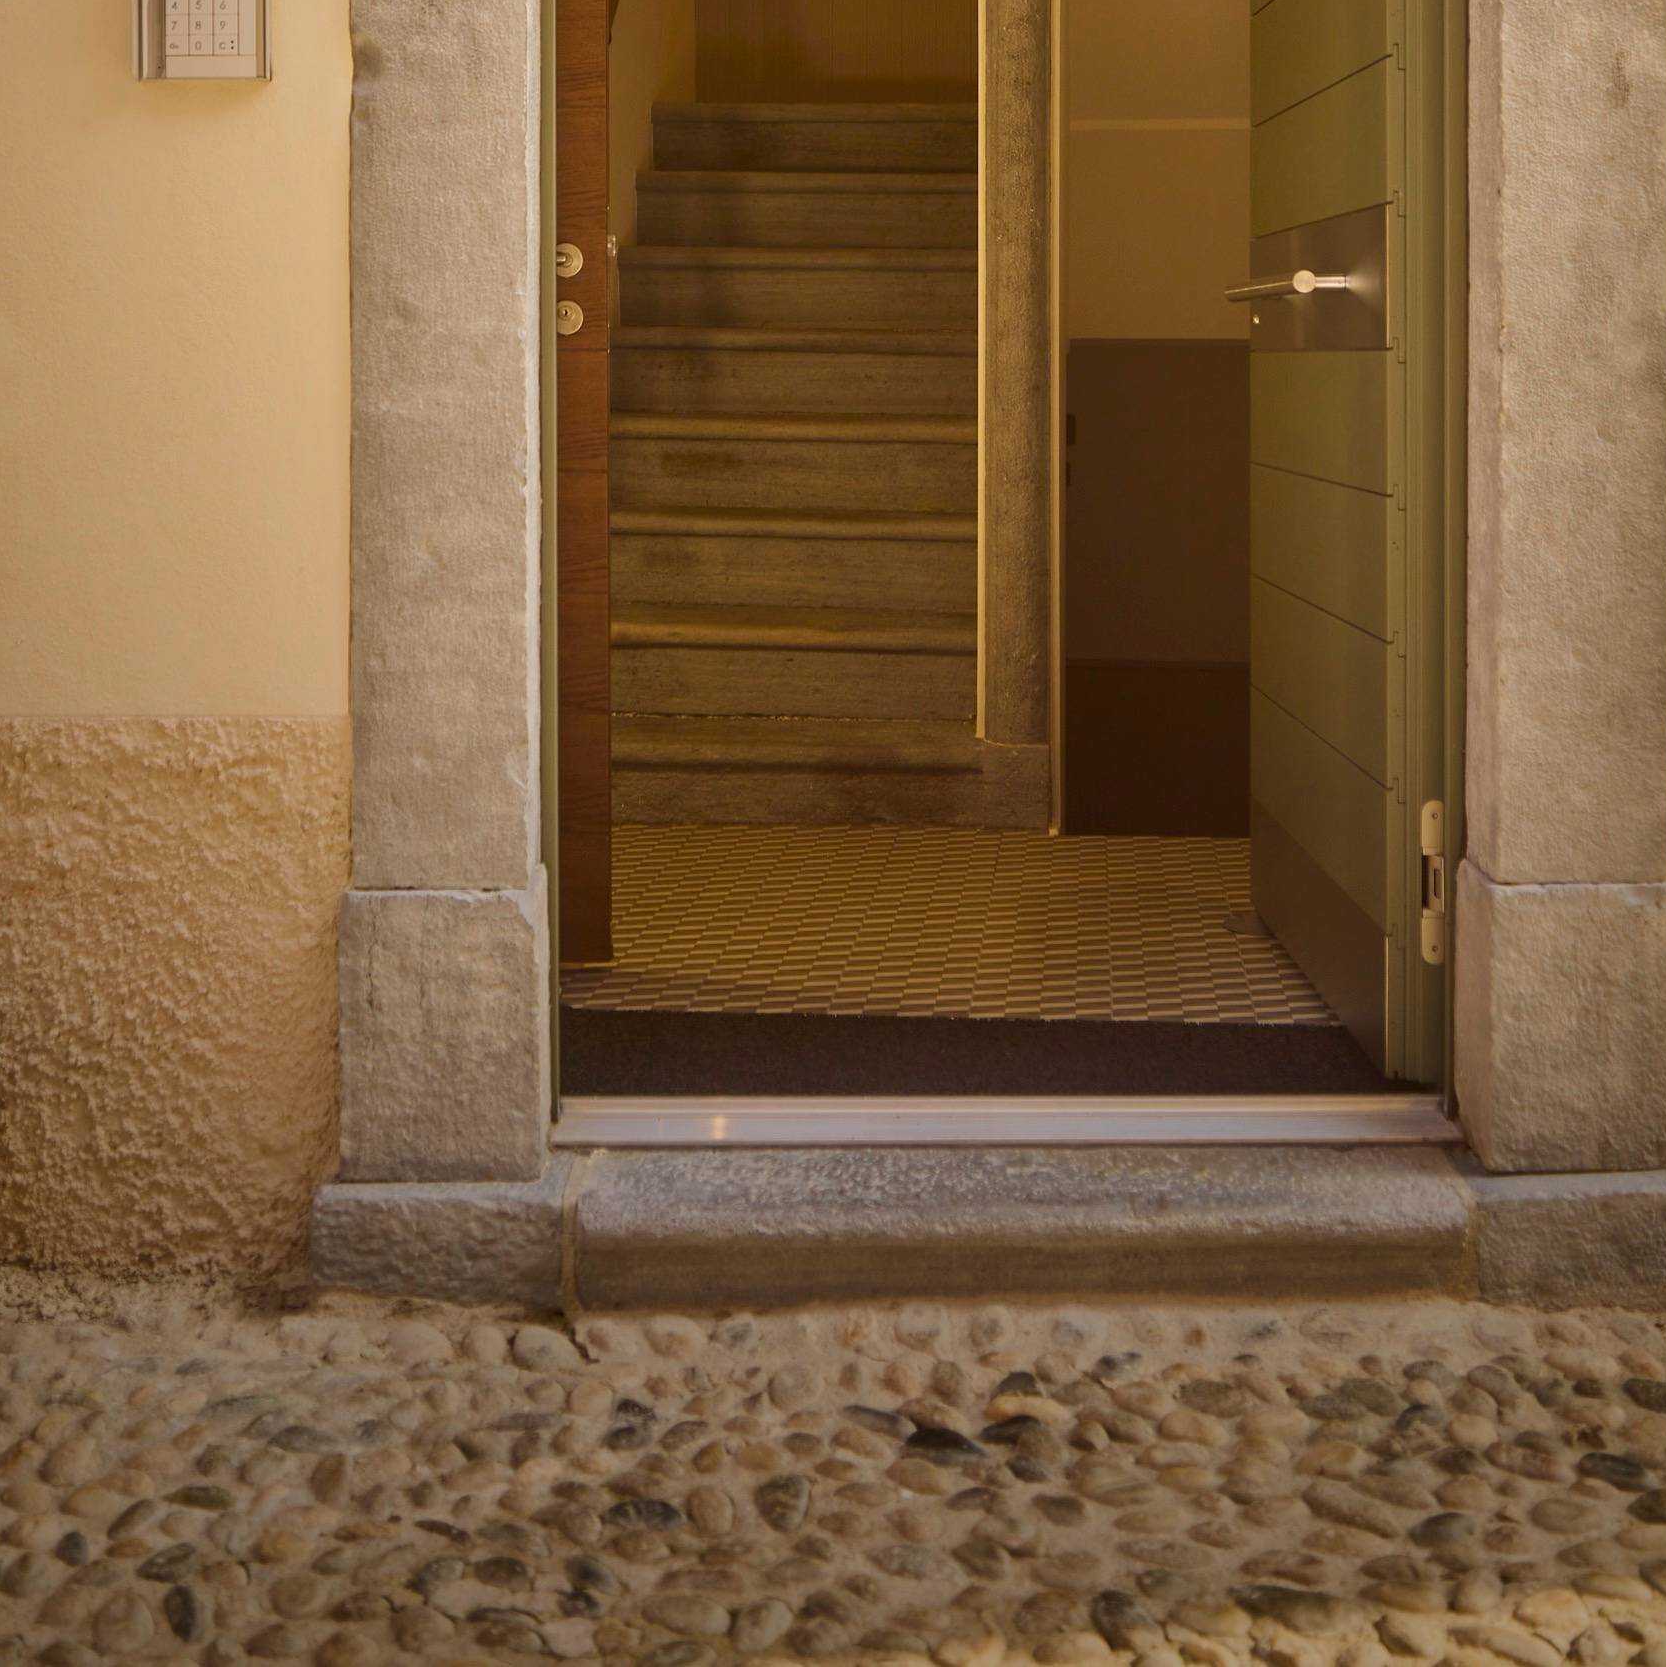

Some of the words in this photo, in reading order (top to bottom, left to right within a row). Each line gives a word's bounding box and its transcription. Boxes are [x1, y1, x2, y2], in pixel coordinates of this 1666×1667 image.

[171, 1, 178, 11] 4
[195, 0, 202, 10] 5
[219, 0, 226, 10] 6
[171, 20, 178, 31] 7
[195, 20, 202, 30] 8
[219, 20, 226, 31] 9
